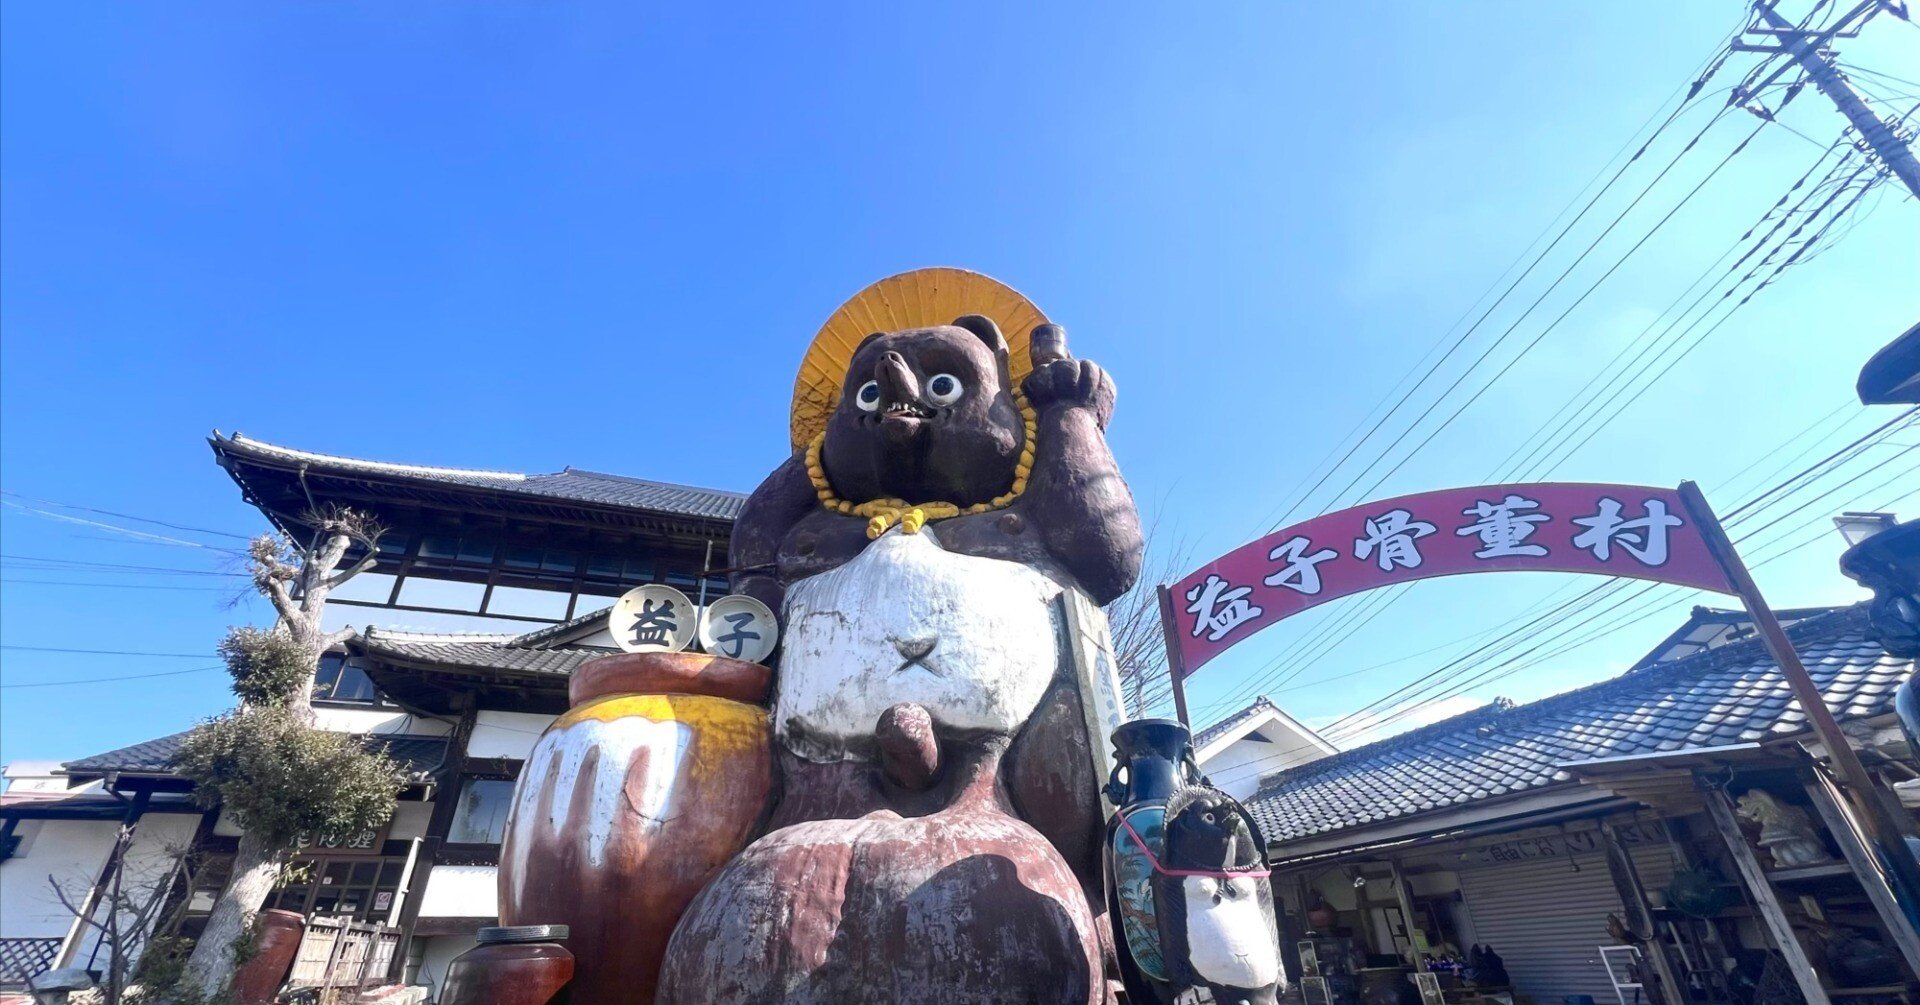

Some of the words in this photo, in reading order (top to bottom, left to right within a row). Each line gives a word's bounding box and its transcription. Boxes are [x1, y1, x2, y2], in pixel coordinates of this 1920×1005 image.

[1186, 495, 1684, 641] 益子骨董村
